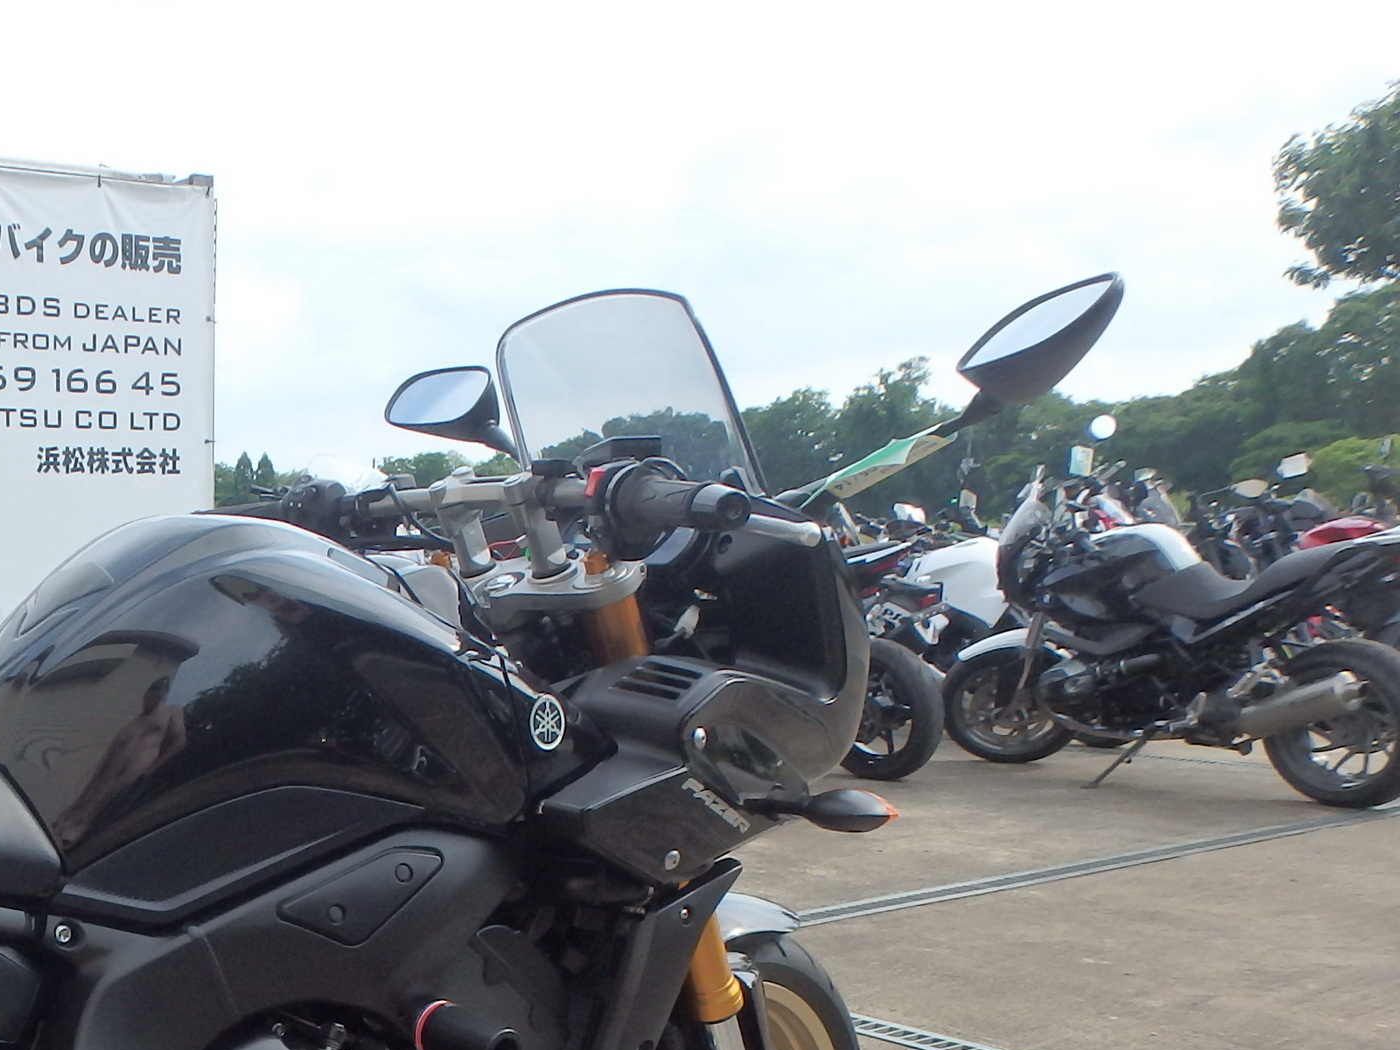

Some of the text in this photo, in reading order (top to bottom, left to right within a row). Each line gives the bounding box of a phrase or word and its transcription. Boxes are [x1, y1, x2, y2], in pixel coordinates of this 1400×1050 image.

[73, 302, 181, 325] DEALER
[82, 333, 182, 356] JAPAN
[51, 368, 118, 394] 166
[131, 372, 182, 397] 45
[75, 410, 118, 430] CO
[129, 412, 181, 432] LTD
[36, 446, 181, 475] 浜松株式会社
